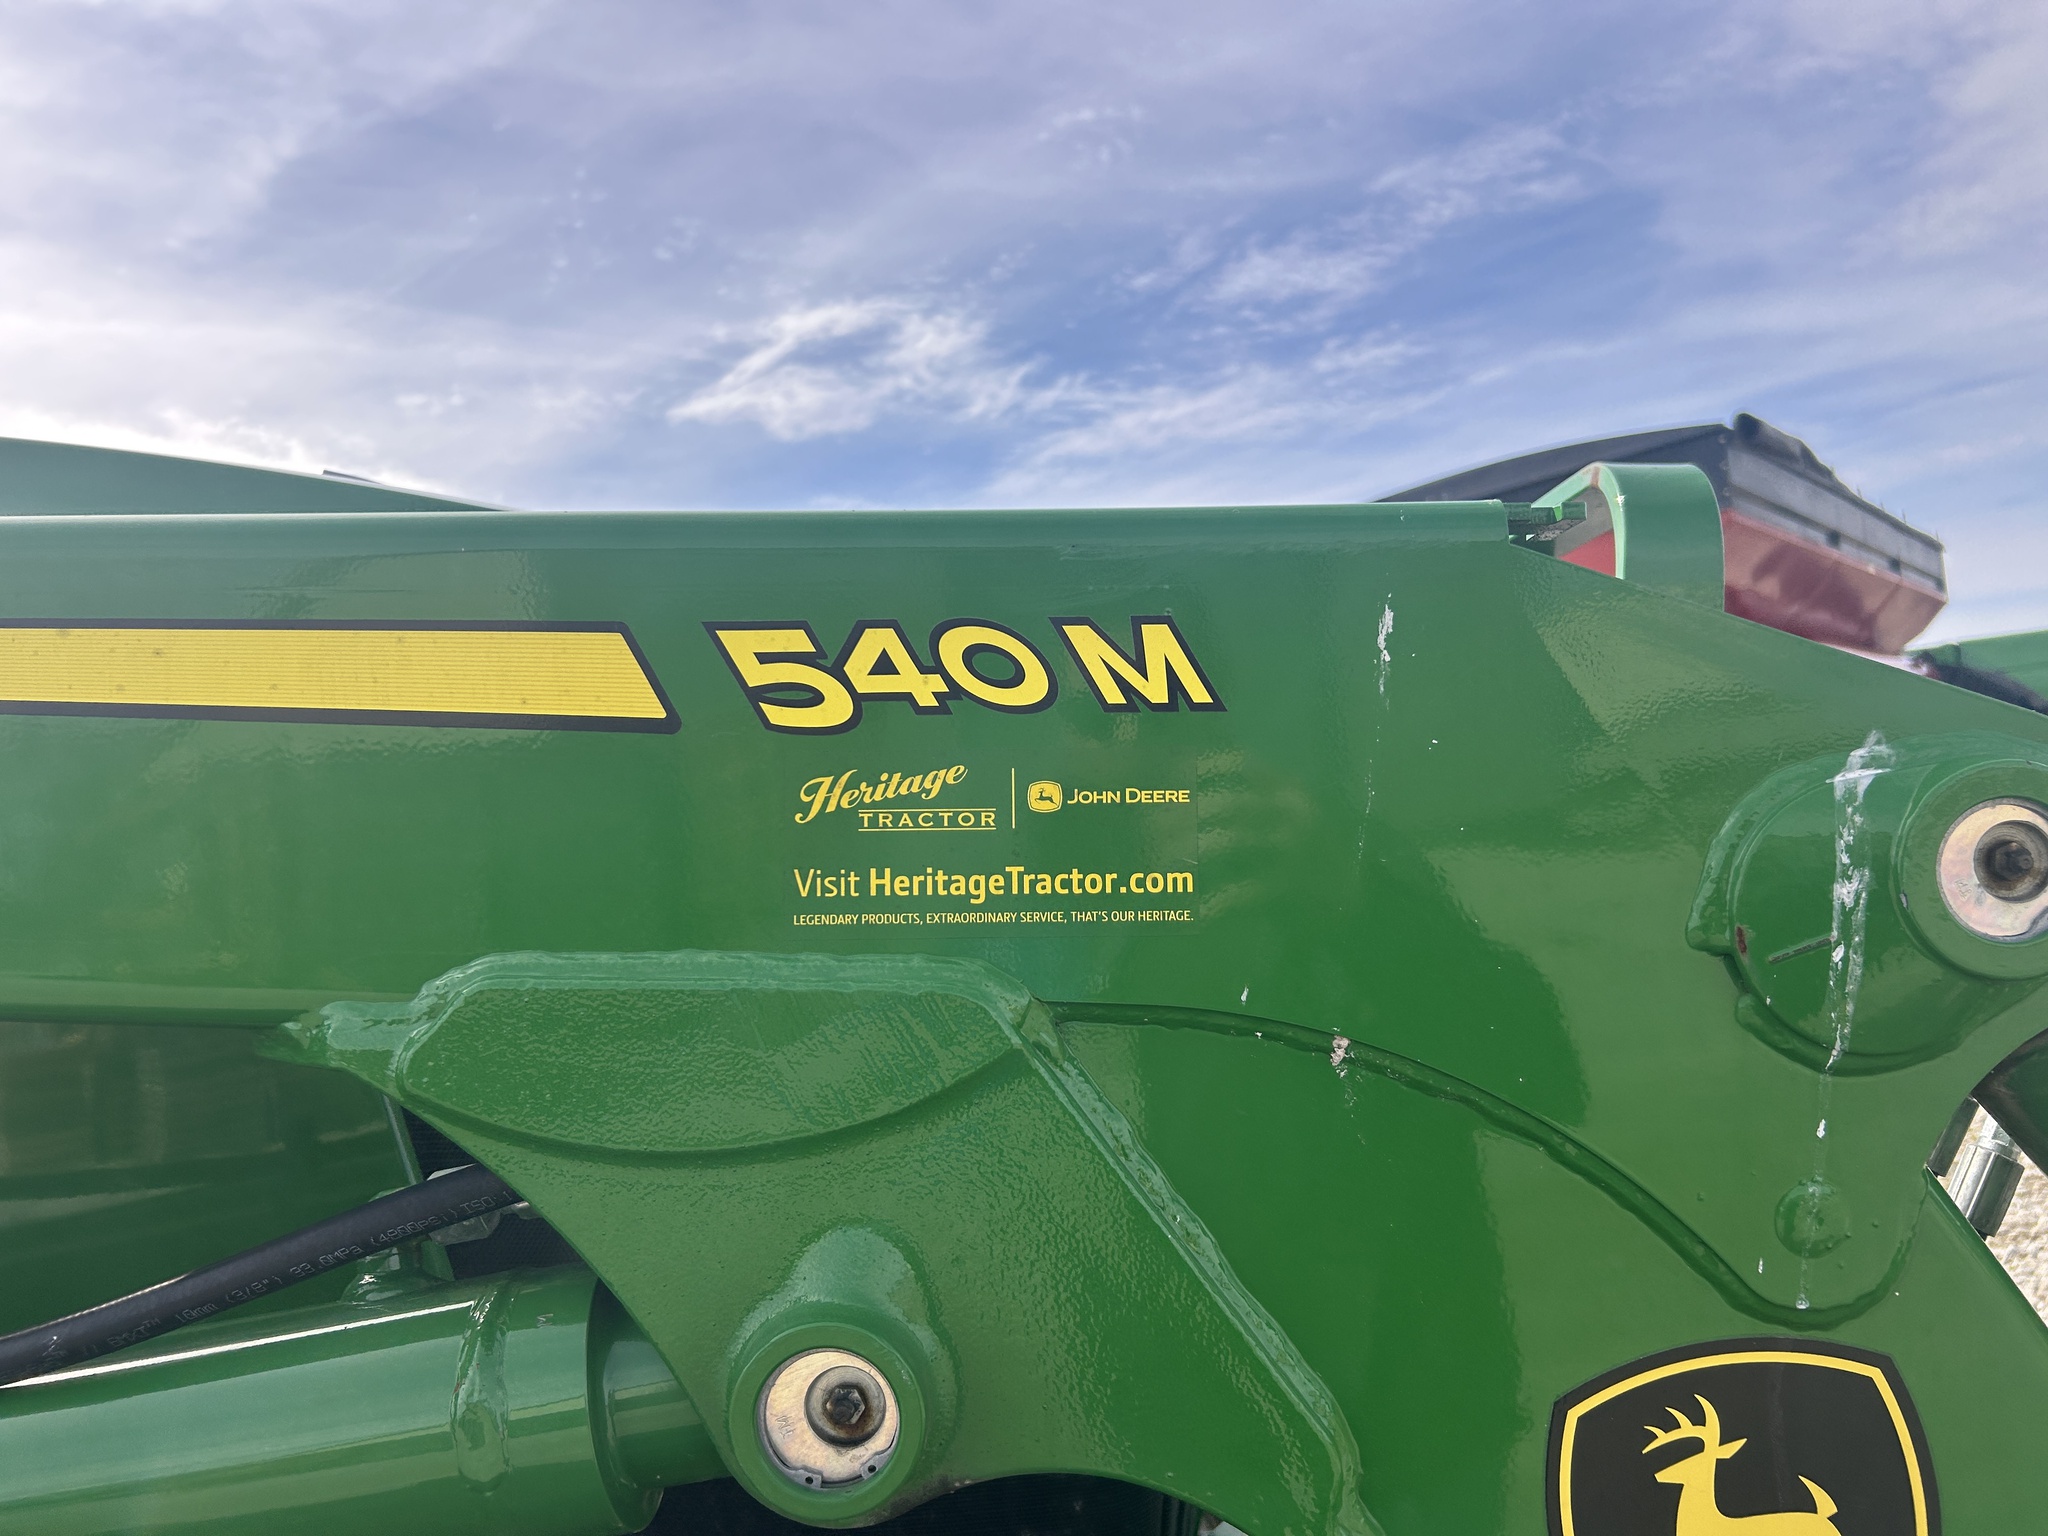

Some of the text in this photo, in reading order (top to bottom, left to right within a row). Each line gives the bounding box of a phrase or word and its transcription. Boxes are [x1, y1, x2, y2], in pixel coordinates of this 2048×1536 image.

[706, 618, 1223, 732] 540 M
[794, 764, 969, 824] Heritage
[1067, 787, 1191, 804] JOHN DEERE
[858, 811, 997, 828] TRACTOR
[794, 866, 1195, 905] Visit HeritageTractor.com
[793, 910, 1195, 926] LEGENDARY PRODUCTS, EXTRAORDINARY SERVICE, THAT'S OUR HERITAGE.
